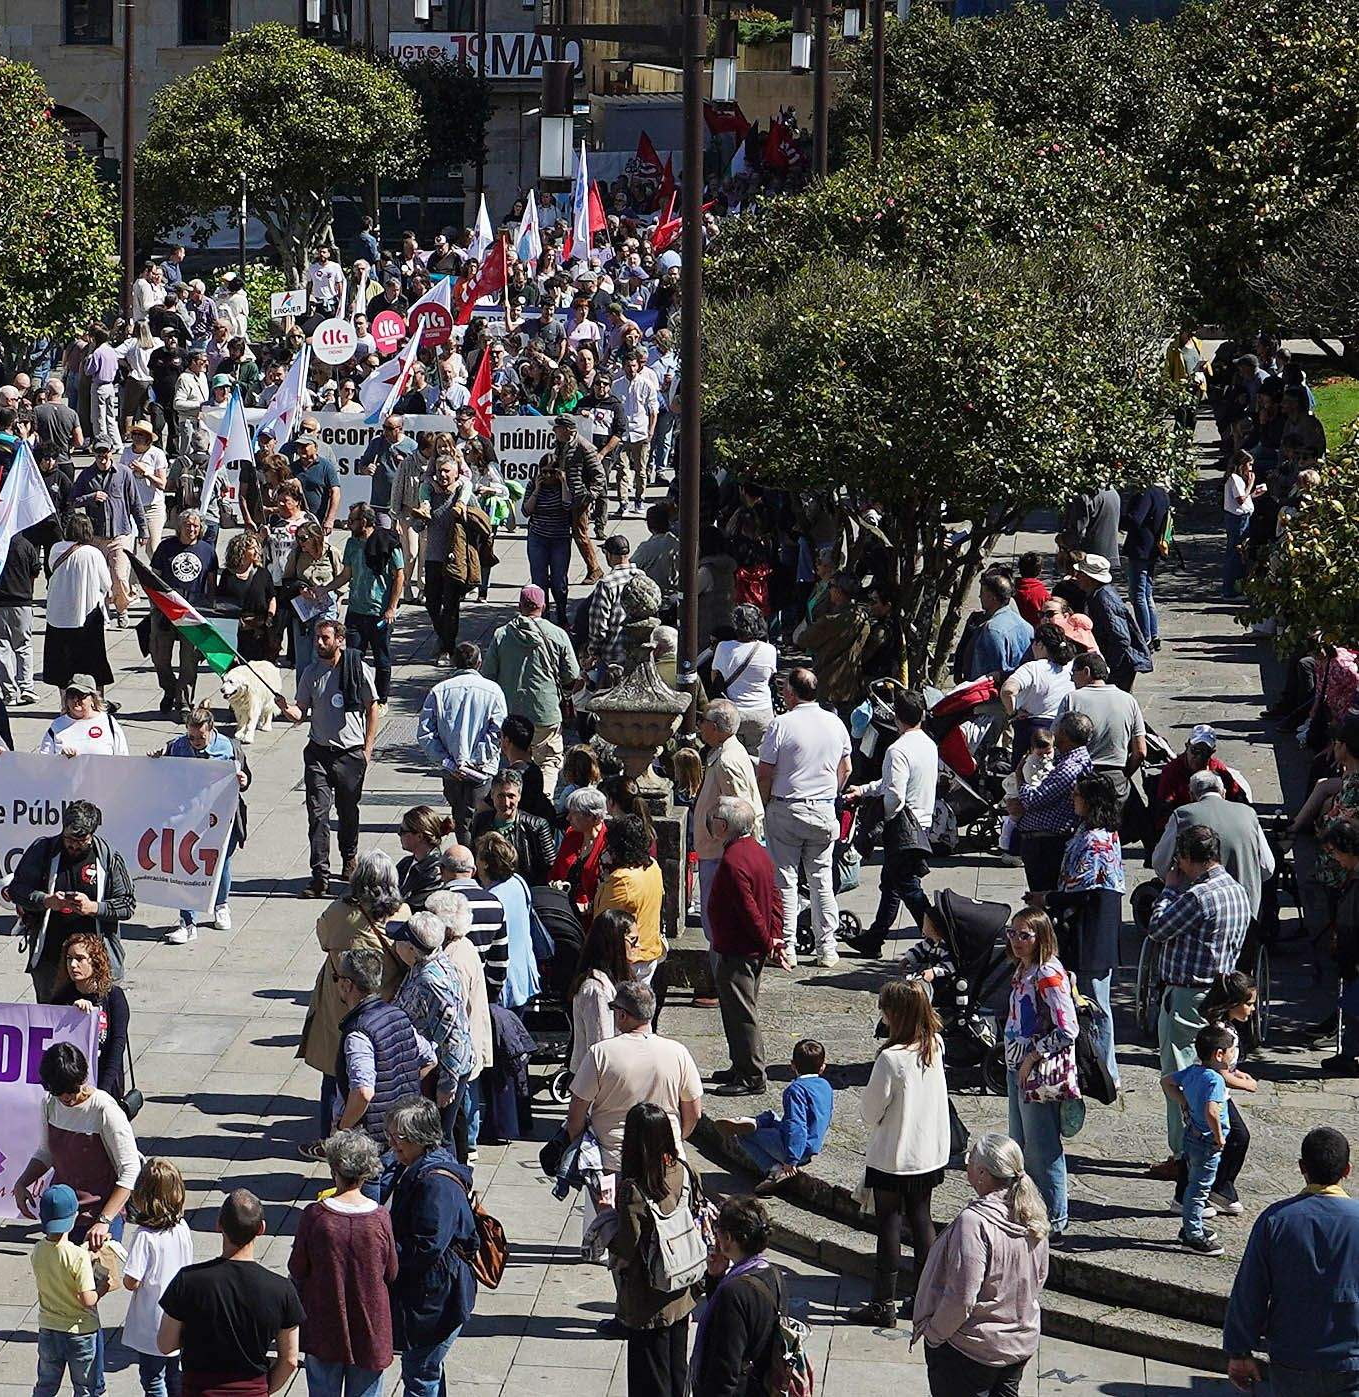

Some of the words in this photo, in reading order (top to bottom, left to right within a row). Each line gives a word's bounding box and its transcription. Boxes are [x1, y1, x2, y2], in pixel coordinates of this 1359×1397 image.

[390, 45, 424, 59] UGT
[322, 329, 348, 345] CIG
[378, 319, 400, 337] CIG
[500, 427, 557, 451] públic
[137, 827, 219, 877] CIG
